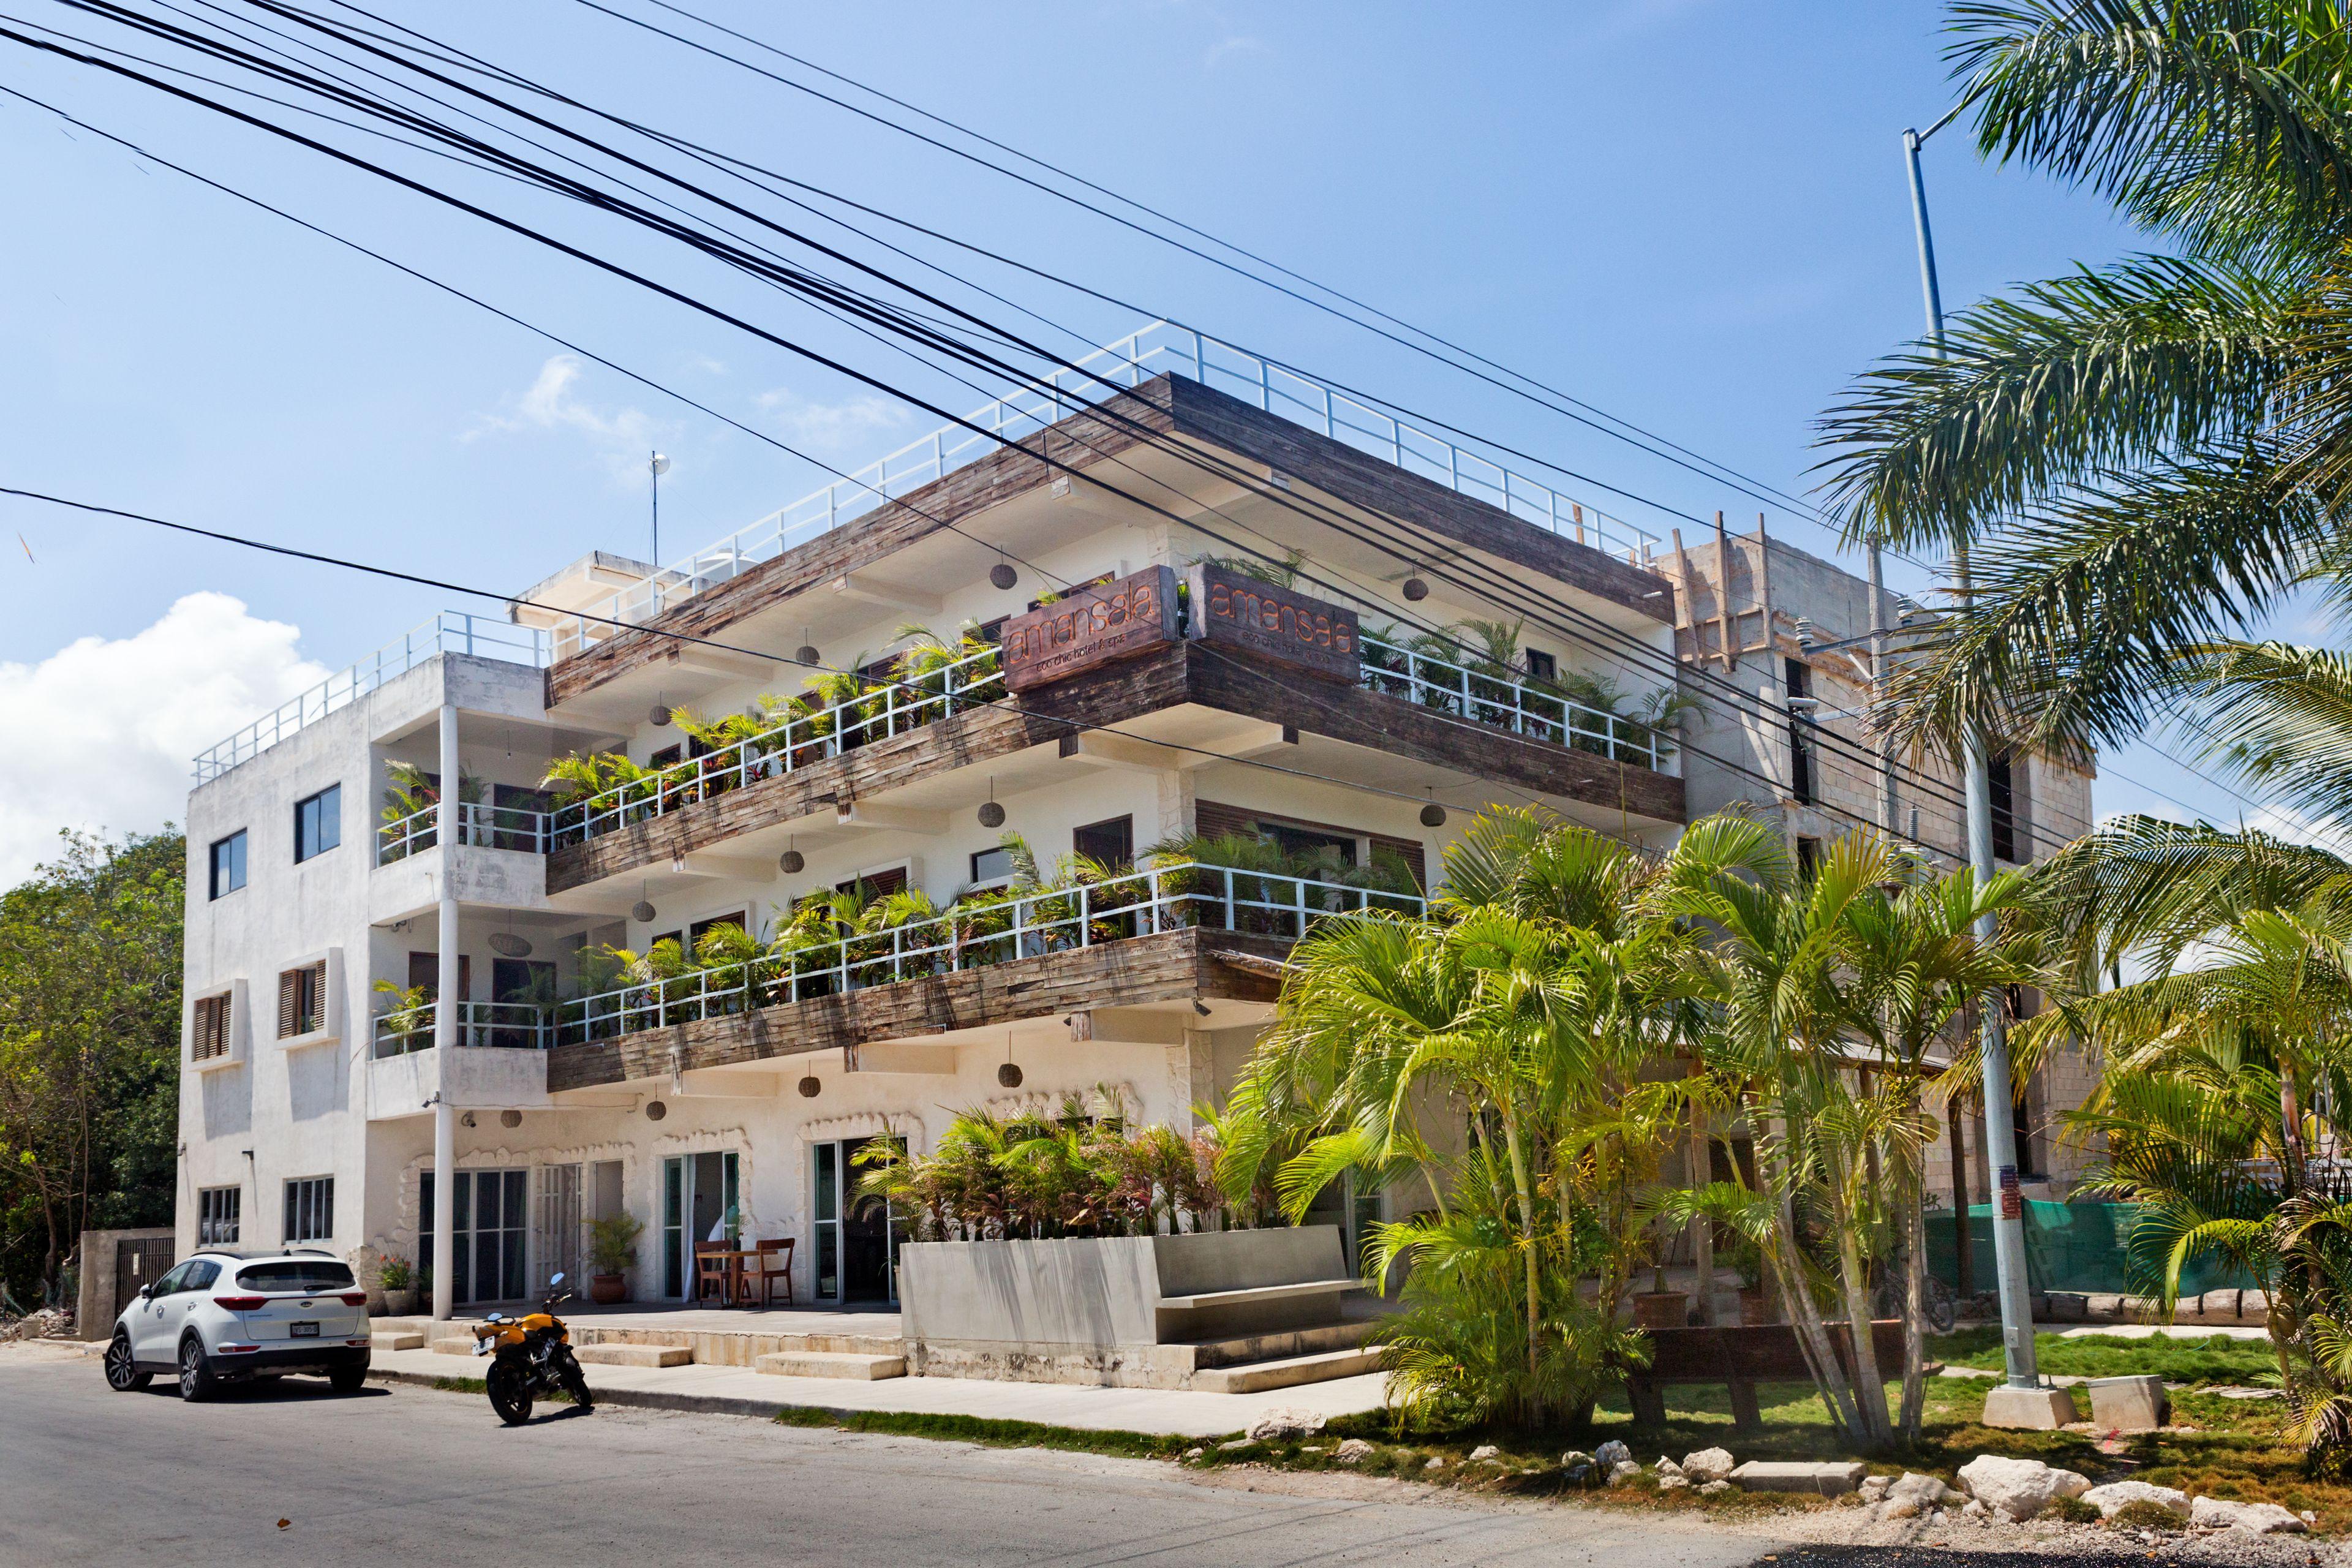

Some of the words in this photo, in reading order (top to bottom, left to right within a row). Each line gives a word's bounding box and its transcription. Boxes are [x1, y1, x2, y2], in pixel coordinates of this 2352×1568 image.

[1008, 581, 1155, 665] amansala
[1212, 584, 1354, 654] amansala
[1242, 631, 1259, 644] eco
[1036, 660, 1052, 673] eco
[1054, 653, 1072, 666] chic
[1074, 641, 1096, 660] hotel
[1098, 638, 1105, 651] &
[1108, 633, 1126, 648] spa
